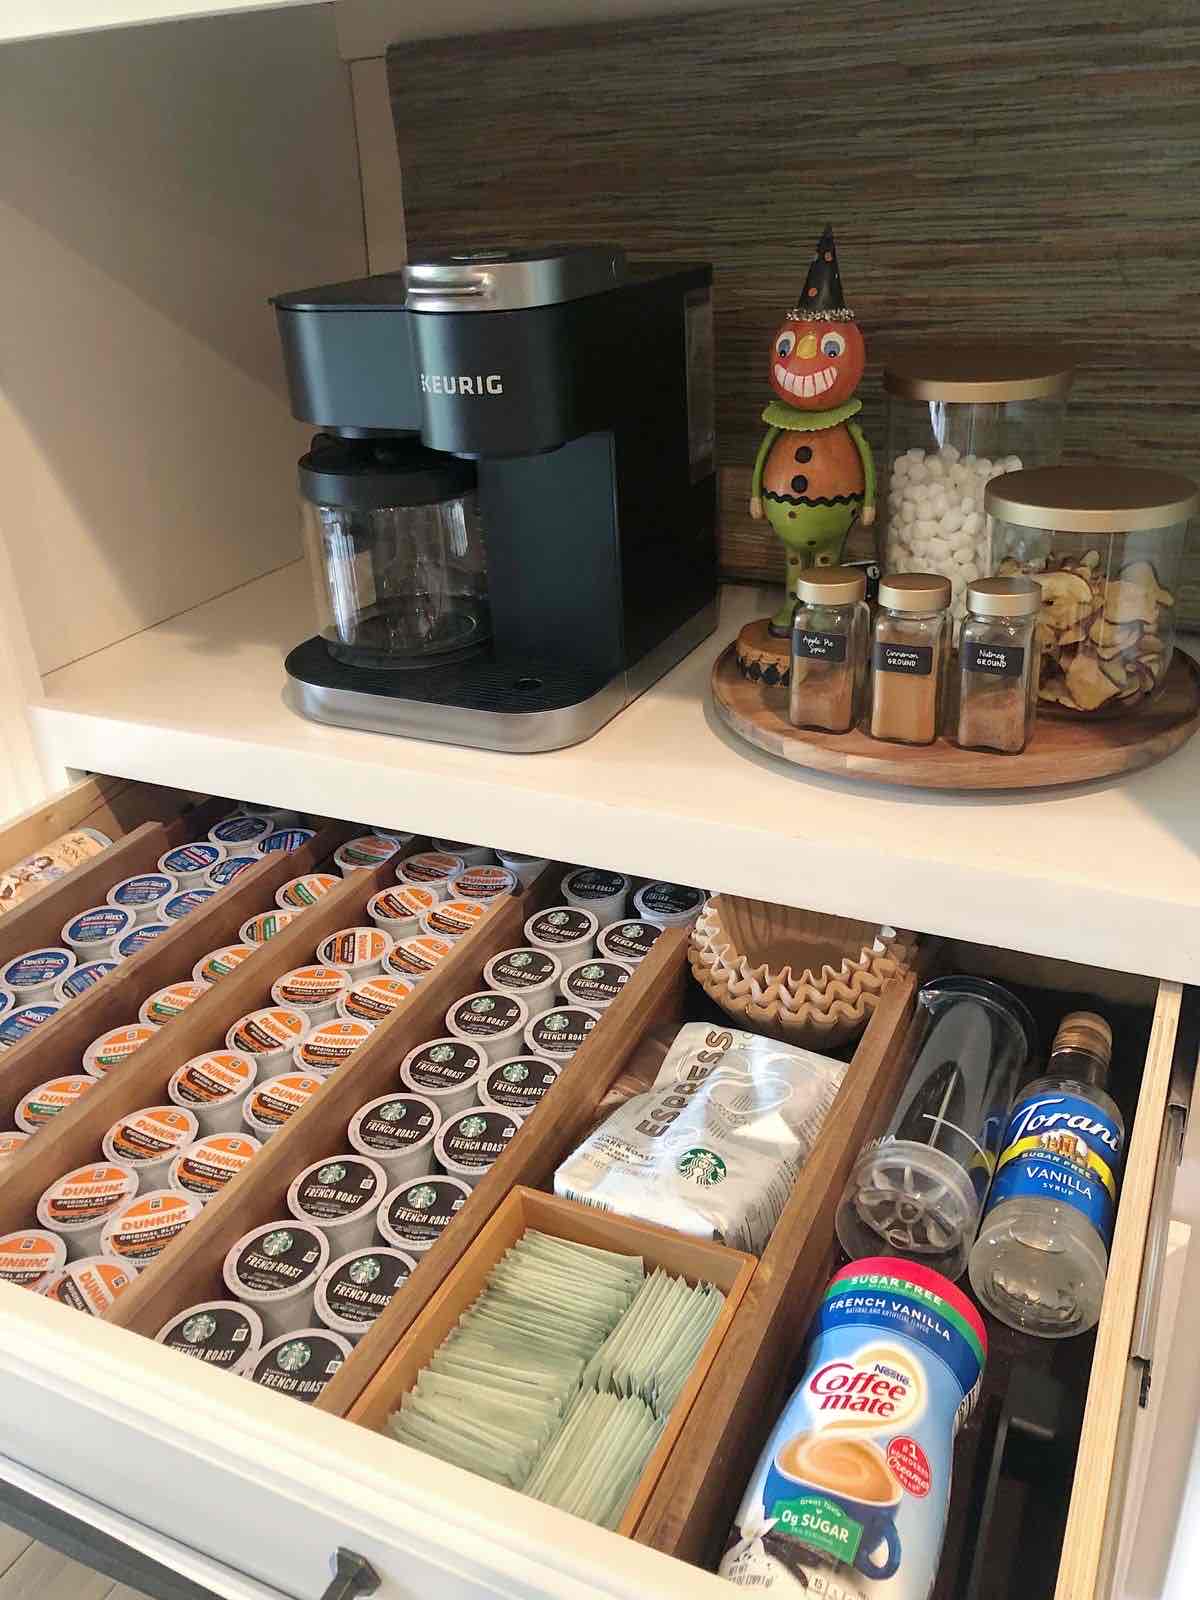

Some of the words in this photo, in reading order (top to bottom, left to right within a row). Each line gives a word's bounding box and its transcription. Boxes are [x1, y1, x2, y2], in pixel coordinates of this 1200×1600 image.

[421, 374, 504, 395] KEURIG
[888, 658, 916, 667] GROUND
[976, 658, 1007, 668] GROUND
[979, 649, 1007, 660] Nutmeg
[536, 923, 561, 934] FRENCH
[560, 929, 580, 937] ROAST
[497, 964, 522, 977] FRENCH
[522, 971, 544, 981] ROAST
[572, 979, 599, 988] FRENCH
[460, 1013, 485, 1024] FRENCH
[485, 1016, 510, 1027] ROAST
[538, 1032, 567, 1041] FRENCH
[567, 1033, 588, 1041] ROAS
[415, 1061, 443, 1075] FRENCH
[442, 1067, 467, 1080] ROAST
[492, 1082, 522, 1094] FRENCH
[365, 1121, 396, 1134] FRENCH
[395, 1127, 420, 1140] ROAST
[449, 1138, 481, 1150] FRENCH
[1021, 1151, 1060, 1163] SUGAR
[1063, 1159, 1092, 1179] FREE
[1026, 1166, 1092, 1200] VANILLA
[1042, 1181, 1075, 1196] SYRUP
[304, 1187, 336, 1199] FRENCH
[335, 1191, 363, 1204] ROAST
[394, 1209, 428, 1223] FRENCH
[119, 1230, 159, 1241] ORIGINAL
[244, 1255, 276, 1272] FRENCH
[275, 1262, 303, 1279] ROAST
[333, 1284, 369, 1301] FRENCH
[367, 1293, 392, 1306] ROAS
[850, 1274, 900, 1287] SUGAR
[904, 1280, 944, 1306] FREE
[829, 1297, 886, 1313] FRENCH
[891, 1301, 951, 1341] VANILLA
[204, 1349, 236, 1361] ROAST
[260, 1372, 298, 1390] FRENCH
[297, 1380, 328, 1392] ROAST
[810, 1363, 907, 1401] Coffee
[820, 1394, 895, 1417] mate
[781, 1509, 799, 1527] 0g
[801, 1513, 849, 1544] SUGAR
